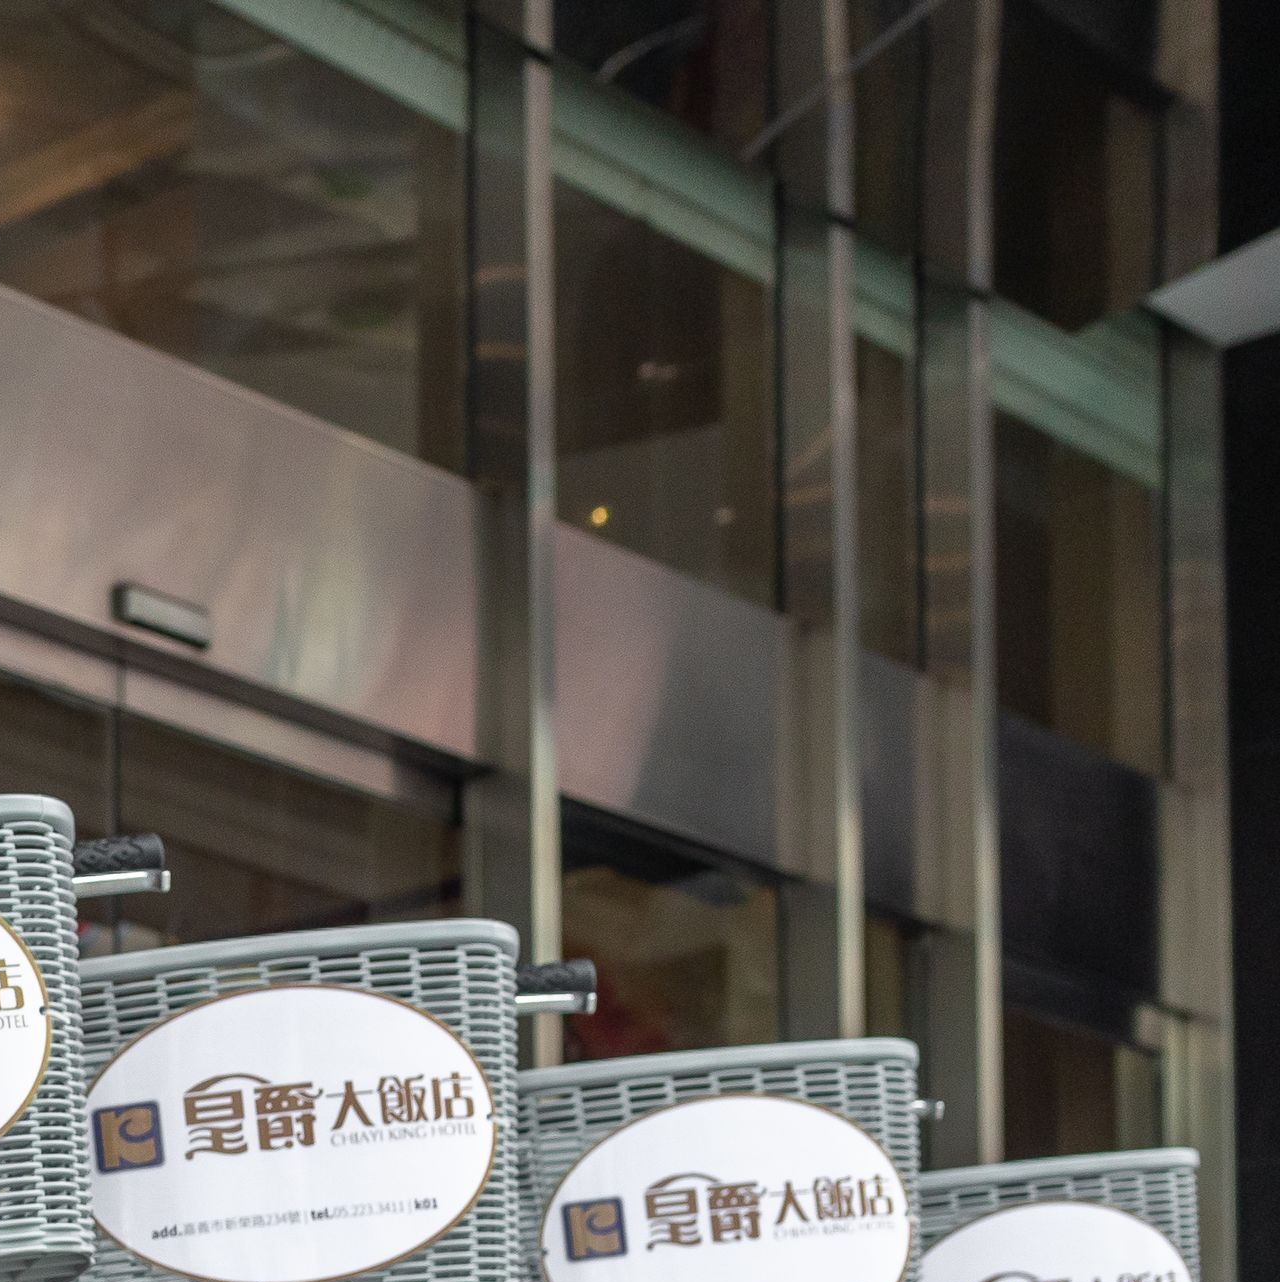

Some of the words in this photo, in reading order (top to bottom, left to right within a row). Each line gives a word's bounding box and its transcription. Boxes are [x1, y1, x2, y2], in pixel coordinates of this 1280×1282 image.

[183, 1072, 474, 1160] 皇爵大飯店
[330, 1129, 385, 1147] CHIAYI
[388, 1124, 427, 1141] KING
[430, 1122, 476, 1138] HOTEL
[645, 1172, 894, 1251] 皇爵大飯店
